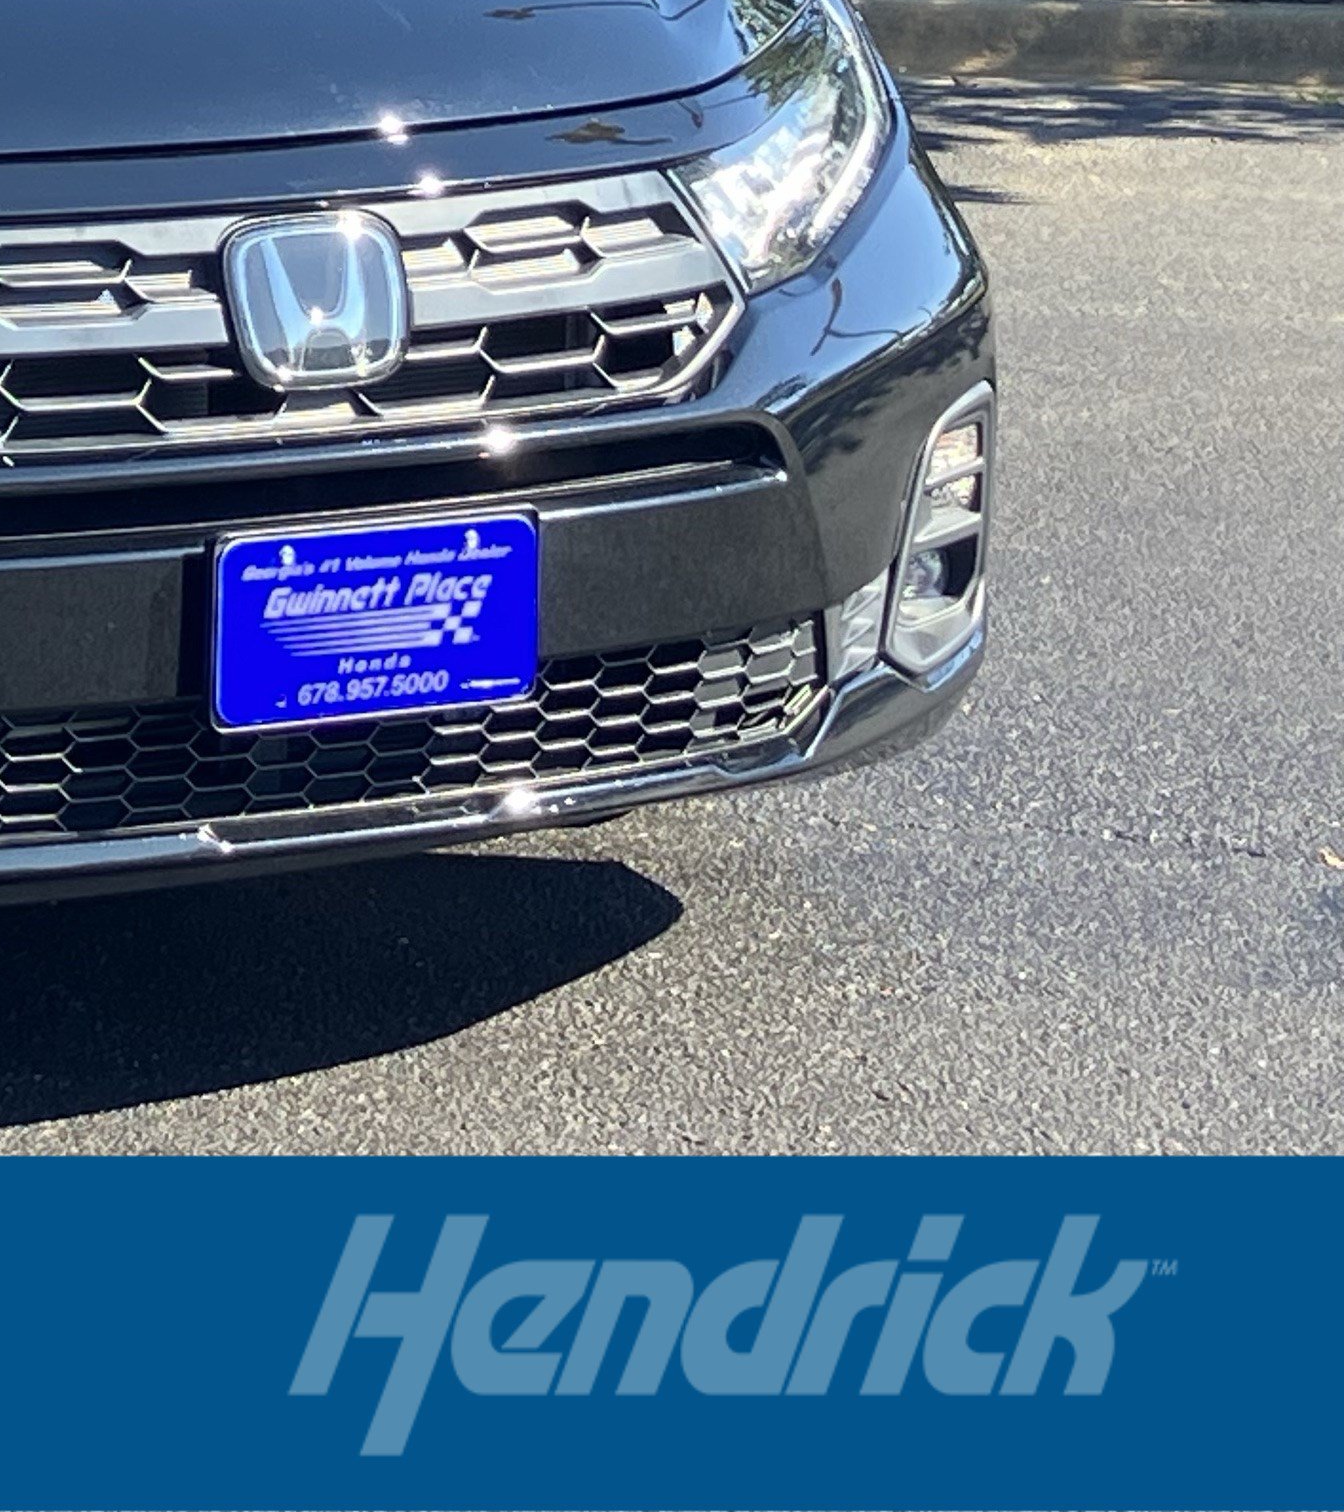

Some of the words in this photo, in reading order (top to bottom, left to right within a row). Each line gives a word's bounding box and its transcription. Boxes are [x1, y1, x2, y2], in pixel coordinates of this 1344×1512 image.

[403, 548, 457, 566] Honda
[263, 576, 401, 619] Gwinnett
[403, 571, 493, 605] Place
[337, 651, 412, 675] Honda
[297, 669, 450, 706] 678.957.5000
